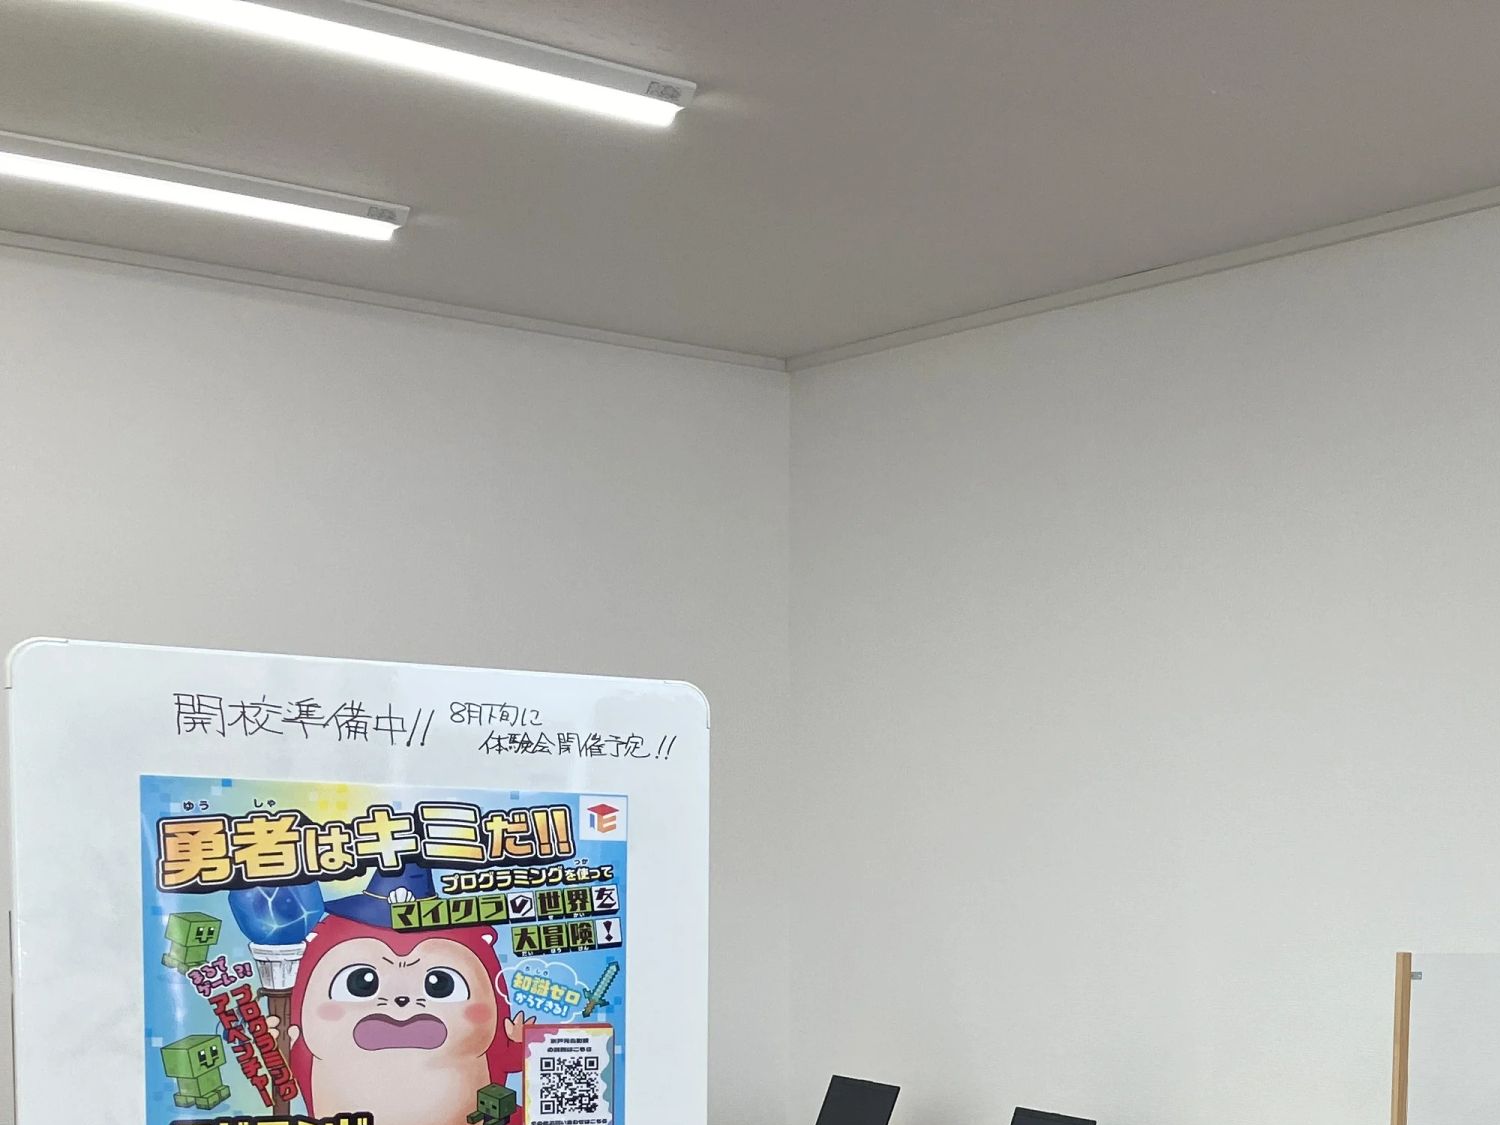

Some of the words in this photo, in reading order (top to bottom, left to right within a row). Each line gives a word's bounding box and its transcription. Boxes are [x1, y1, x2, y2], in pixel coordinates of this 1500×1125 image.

[450, 702, 543, 727] 8月下旬に
[183, 801, 209, 811] ゆう
[253, 799, 276, 808] しゃ
[442, 866, 613, 893] プログラミングを使って
[393, 886, 619, 927] マイクラの世界を
[188, 956, 229, 984] まるで
[513, 972, 581, 1006] 知識ゼロ
